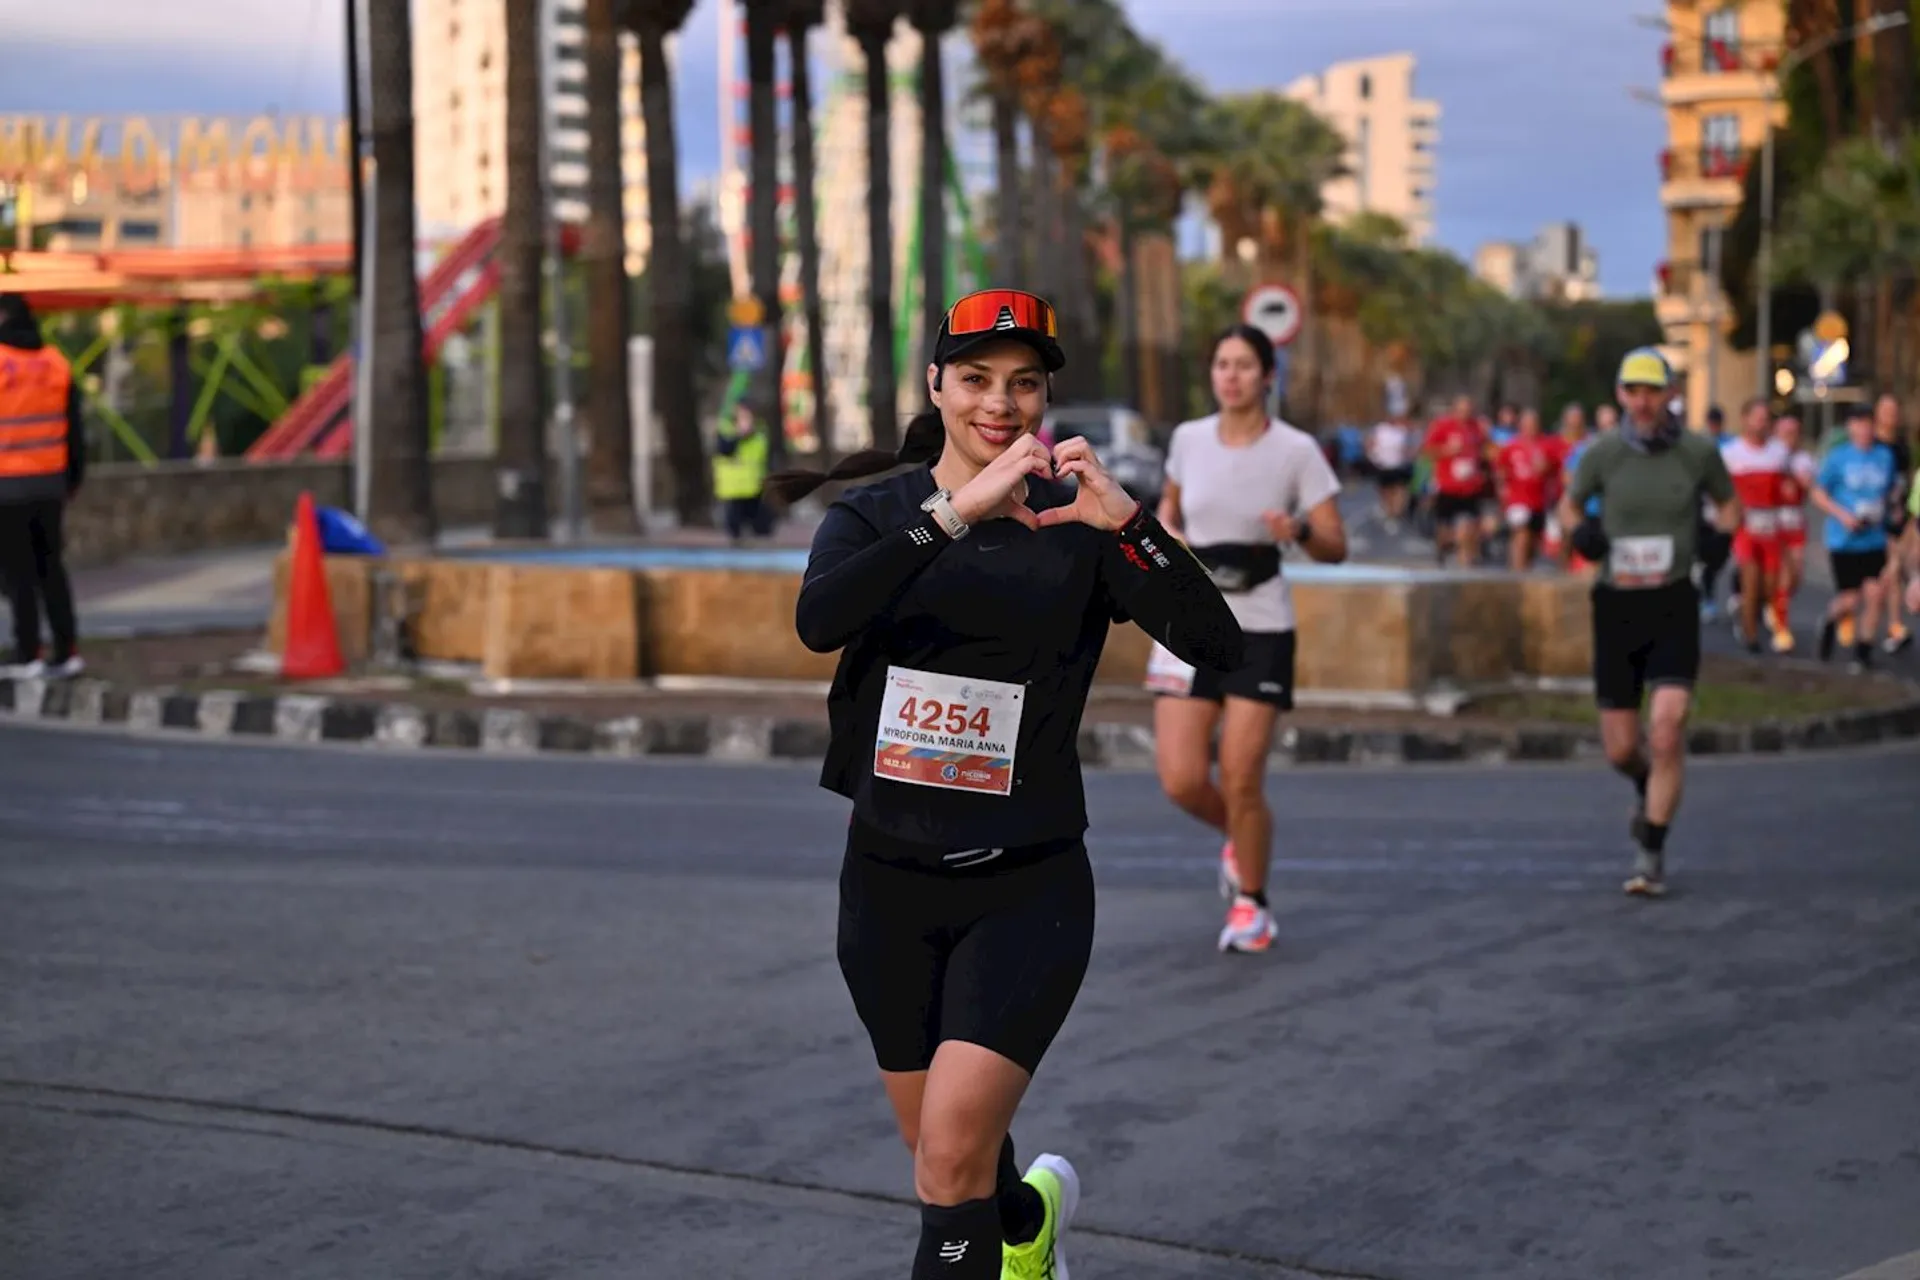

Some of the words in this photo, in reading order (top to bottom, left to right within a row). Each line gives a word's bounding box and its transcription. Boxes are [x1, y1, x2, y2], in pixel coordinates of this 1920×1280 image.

[898, 696, 991, 738] 4254
[883, 726, 935, 746] MYROFORA
[937, 735, 975, 751] MARIA
[975, 740, 1006, 754] ANNA
